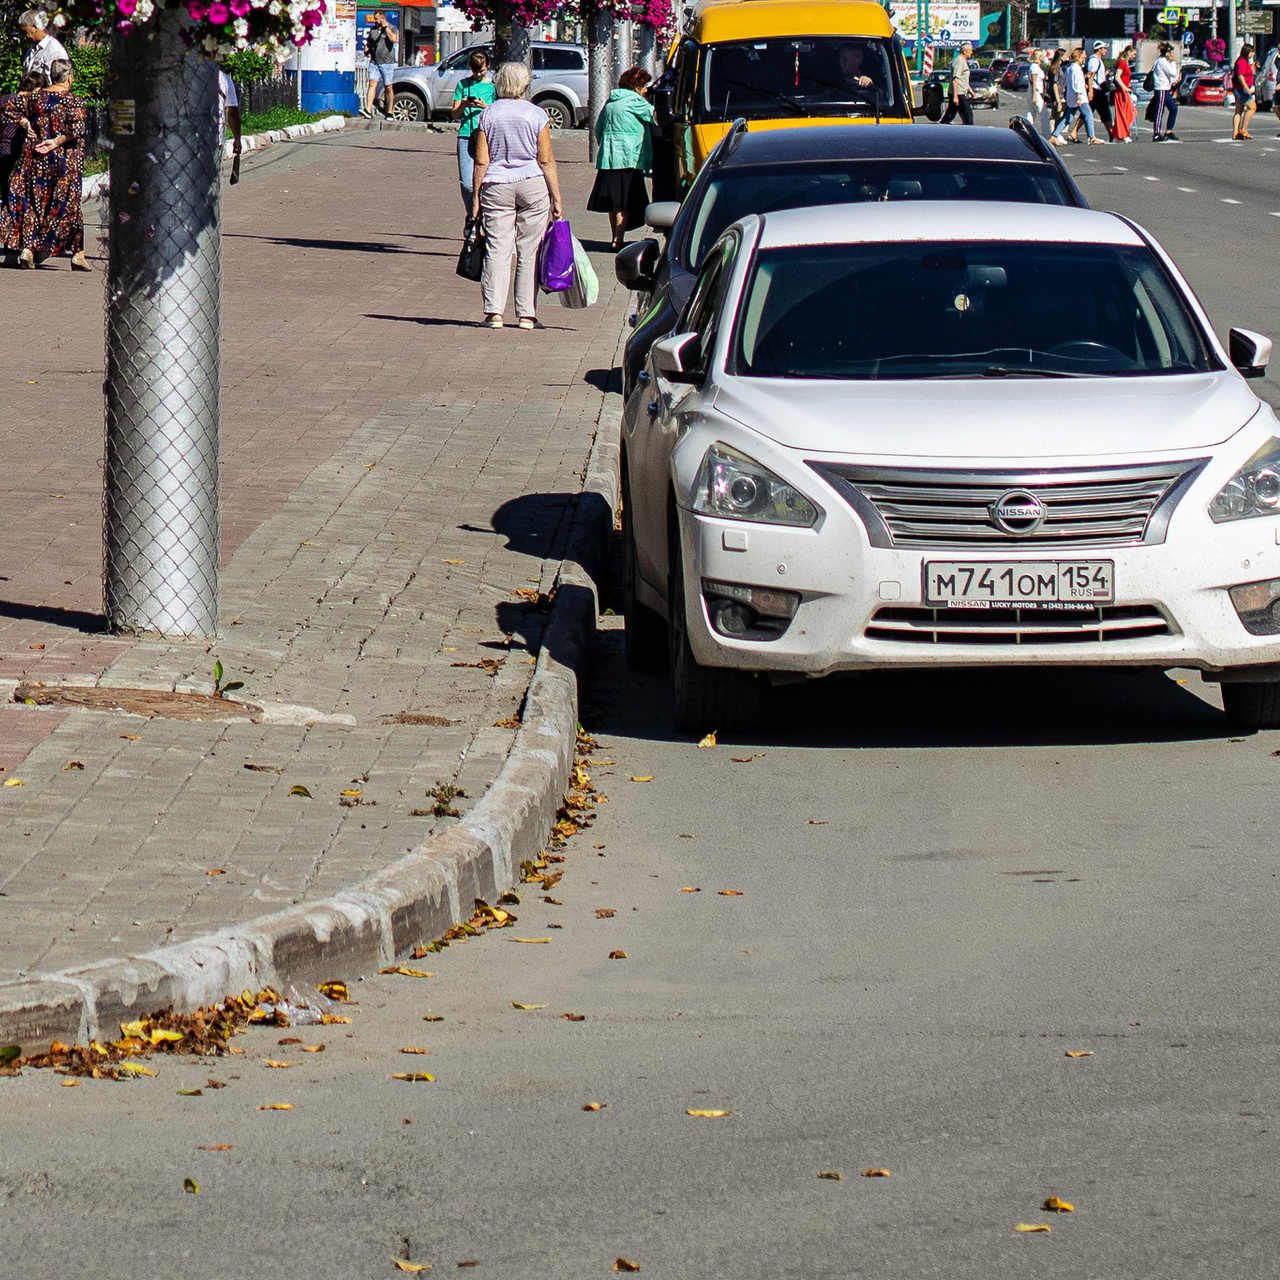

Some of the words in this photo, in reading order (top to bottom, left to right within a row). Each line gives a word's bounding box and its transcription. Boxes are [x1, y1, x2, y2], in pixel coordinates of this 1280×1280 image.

[997, 508, 1040, 516] NISSAN
[1062, 566, 1106, 589] 154
[1071, 588, 1092, 597] RUS
[950, 600, 987, 608] NISSAN
[1012, 601, 1037, 609] MOTORS
